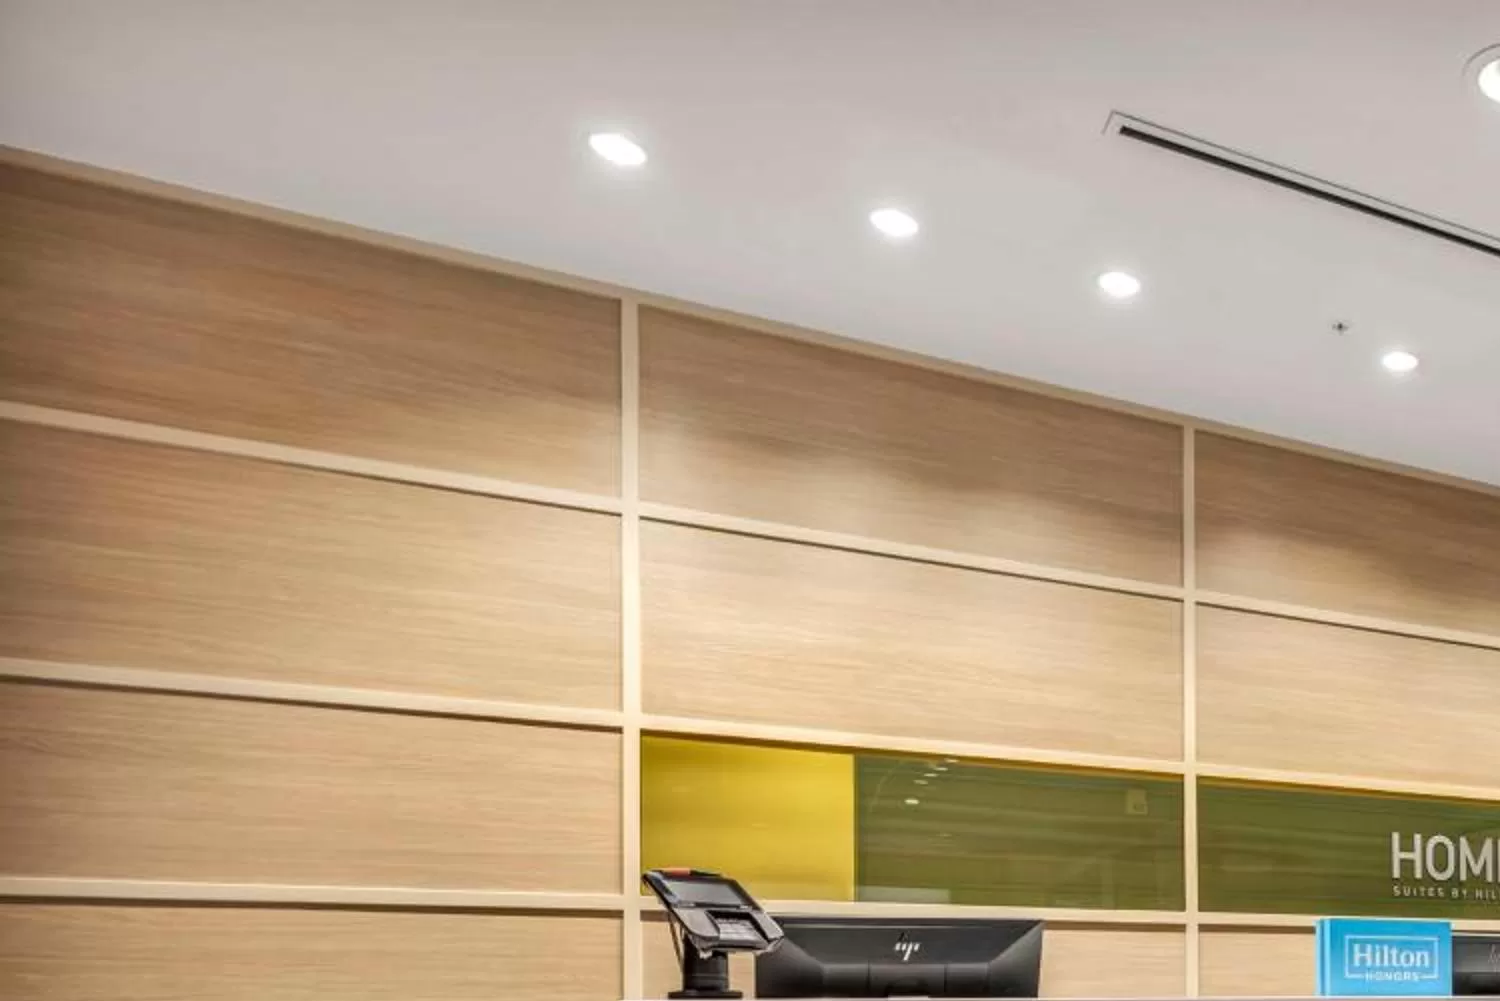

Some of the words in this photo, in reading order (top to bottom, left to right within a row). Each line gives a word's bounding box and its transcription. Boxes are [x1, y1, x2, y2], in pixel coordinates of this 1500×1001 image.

[1392, 885, 1446, 898] SUITES
[1451, 890, 1468, 900] BY
[1353, 943, 1430, 968] Hilton
[1365, 970, 1419, 981] HONORS
